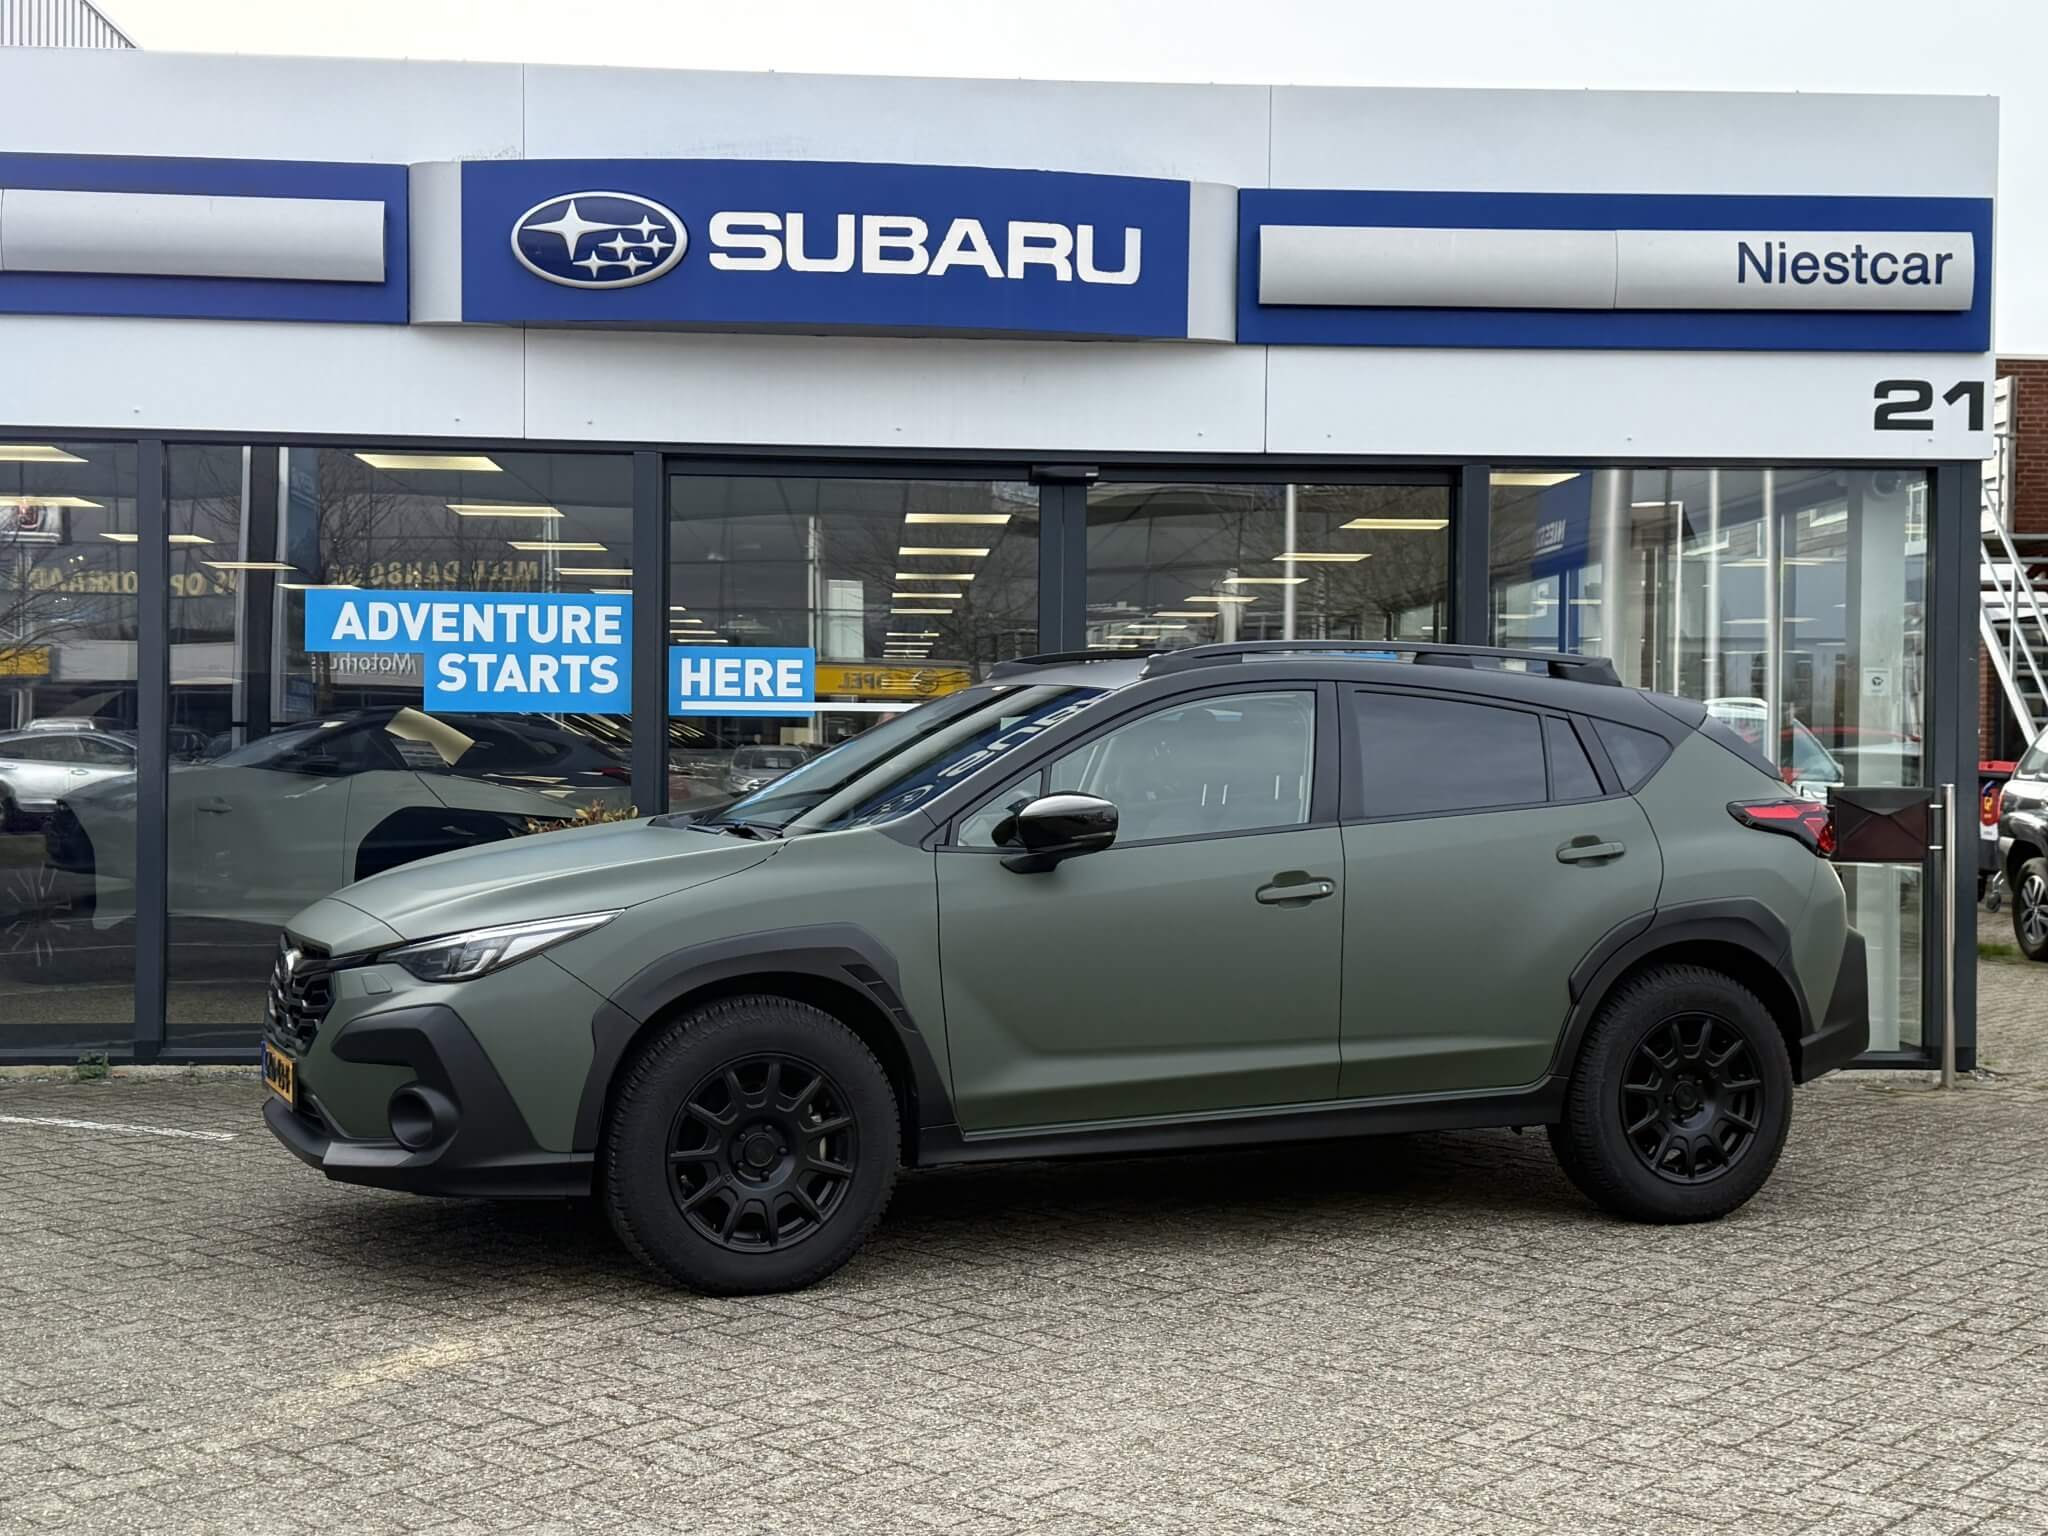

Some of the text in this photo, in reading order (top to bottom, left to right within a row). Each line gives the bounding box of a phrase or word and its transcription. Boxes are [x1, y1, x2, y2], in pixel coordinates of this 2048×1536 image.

[708, 211, 1142, 285] SUBARU
[1737, 241, 1953, 285] Niestcar
[1873, 379, 1985, 431] 21
[331, 601, 623, 645] ADVENTURE
[437, 652, 620, 694] STARTS
[681, 657, 804, 697] HERE
